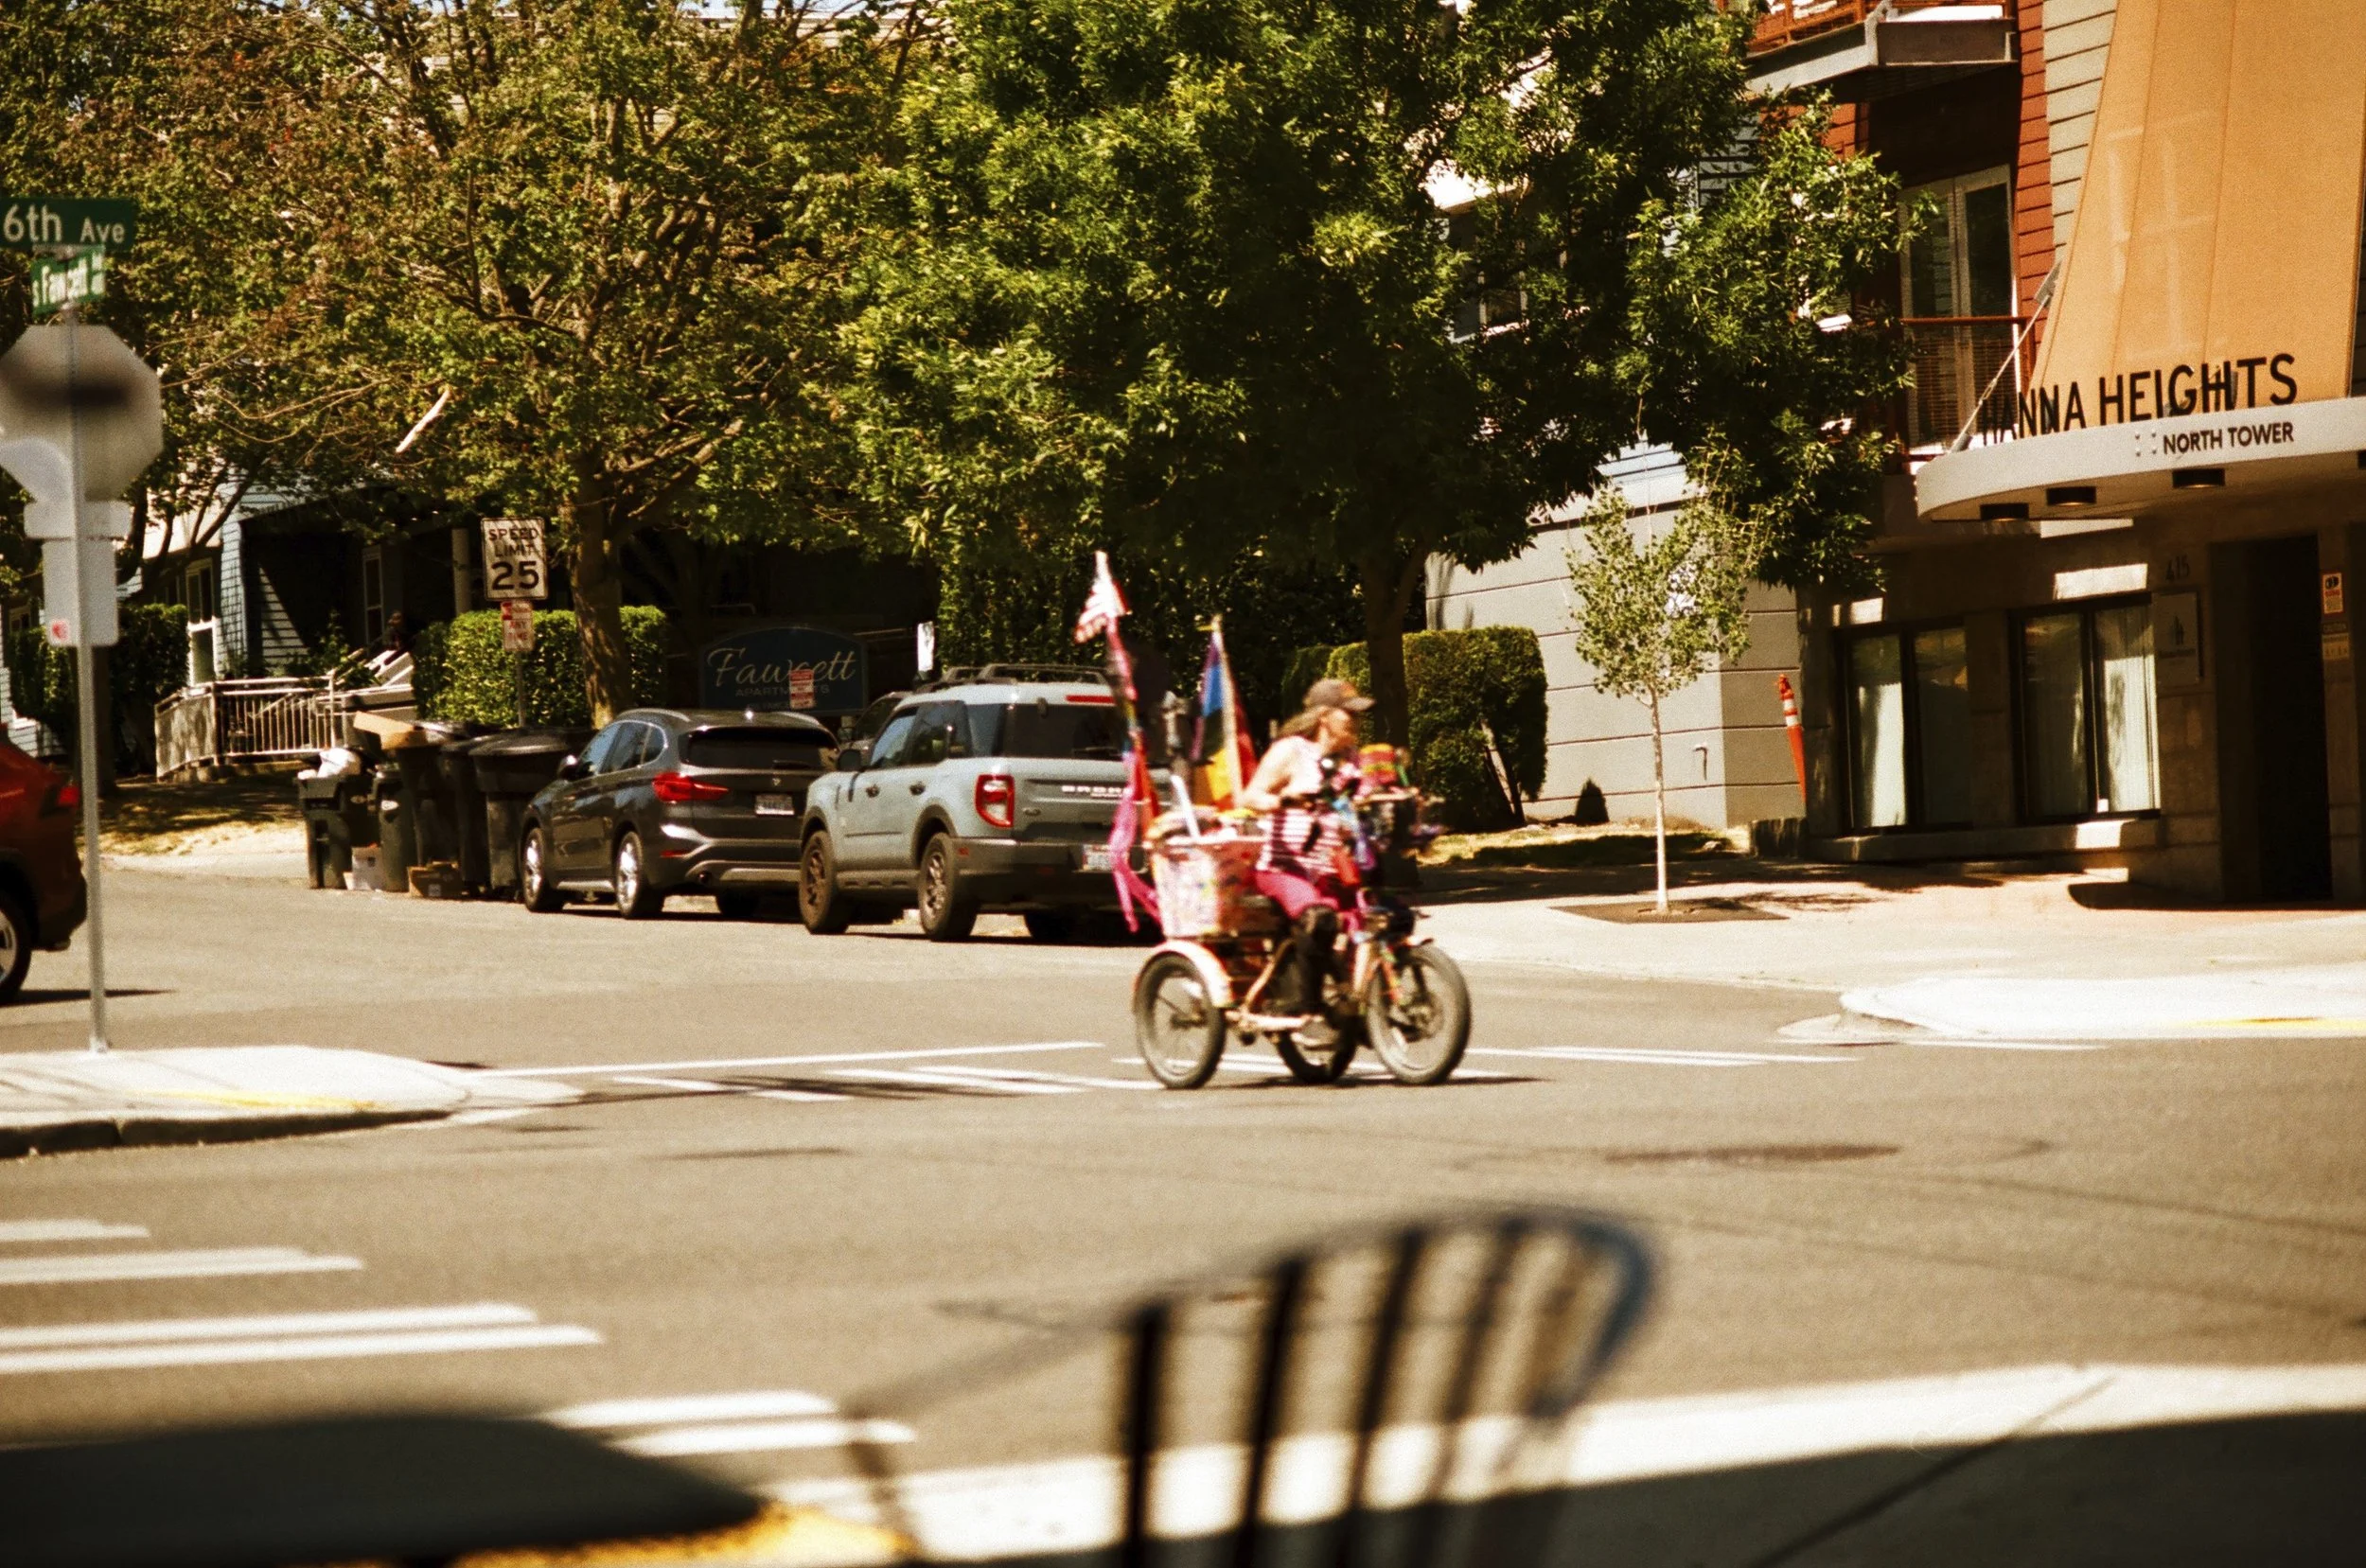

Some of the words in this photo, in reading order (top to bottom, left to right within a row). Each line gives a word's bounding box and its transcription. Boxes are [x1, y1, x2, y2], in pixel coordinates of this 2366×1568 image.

[3, 203, 62, 243] 6th
[79, 217, 126, 244] Ave
[2099, 353, 2298, 427] HEIGHTS
[2163, 429, 2223, 455] NORTH
[2228, 421, 2295, 449] TOWER
[488, 527, 539, 541] SPEED
[495, 543, 536, 557] LIMIT
[491, 560, 539, 590] 25
[735, 684, 830, 697] APARTMTS
